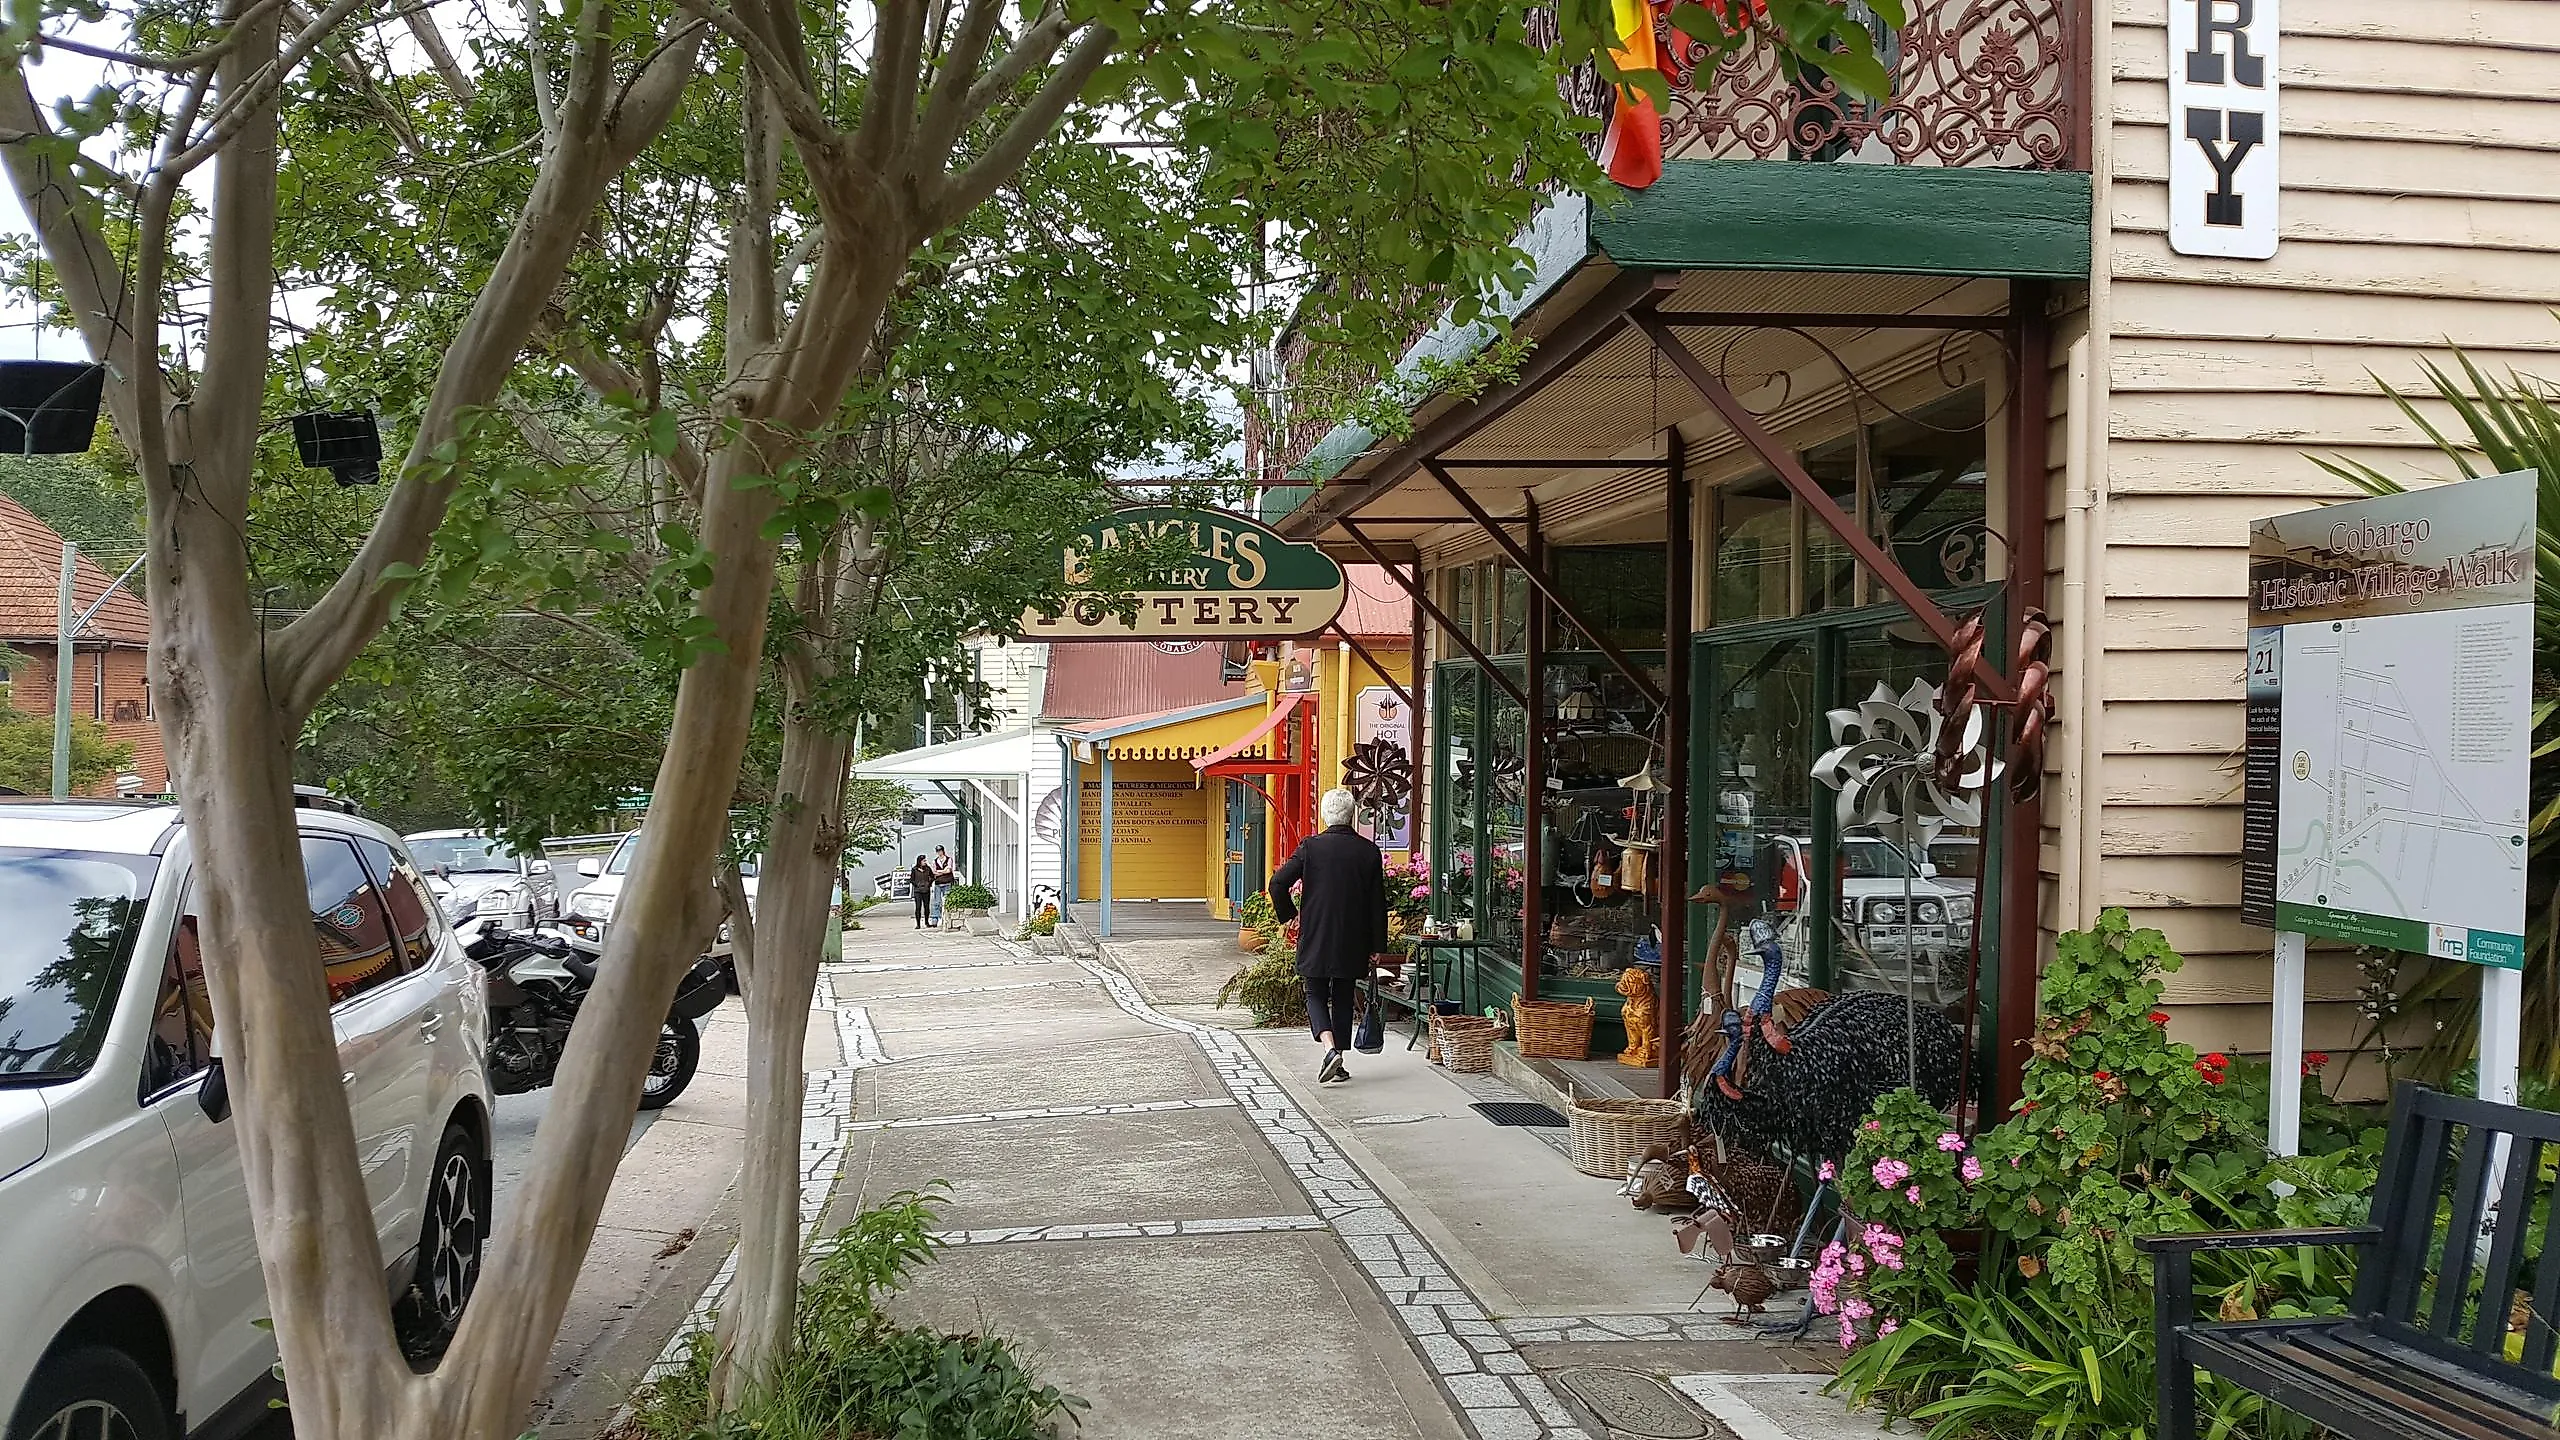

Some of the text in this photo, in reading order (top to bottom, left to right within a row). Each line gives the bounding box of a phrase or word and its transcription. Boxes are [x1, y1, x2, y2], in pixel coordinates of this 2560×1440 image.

[2328, 516, 2432, 557] Cobargo
[2259, 548, 2520, 612] Historic Village Walk
[1154, 641, 1200, 653] COBARGO
[2254, 647, 2275, 676] 21
[1376, 729, 1399, 739] HOT
[1087, 782, 1149, 790] MAACTURERS
[2294, 914, 2314, 926] Cobargo
[2313, 919, 2330, 928] Tourist
[2330, 921, 2340, 929] and
[2340, 922, 2361, 932] Business
[2361, 926, 2390, 937] Association
[2476, 937, 2516, 955] Community
[2469, 948, 2507, 964] Foundation
